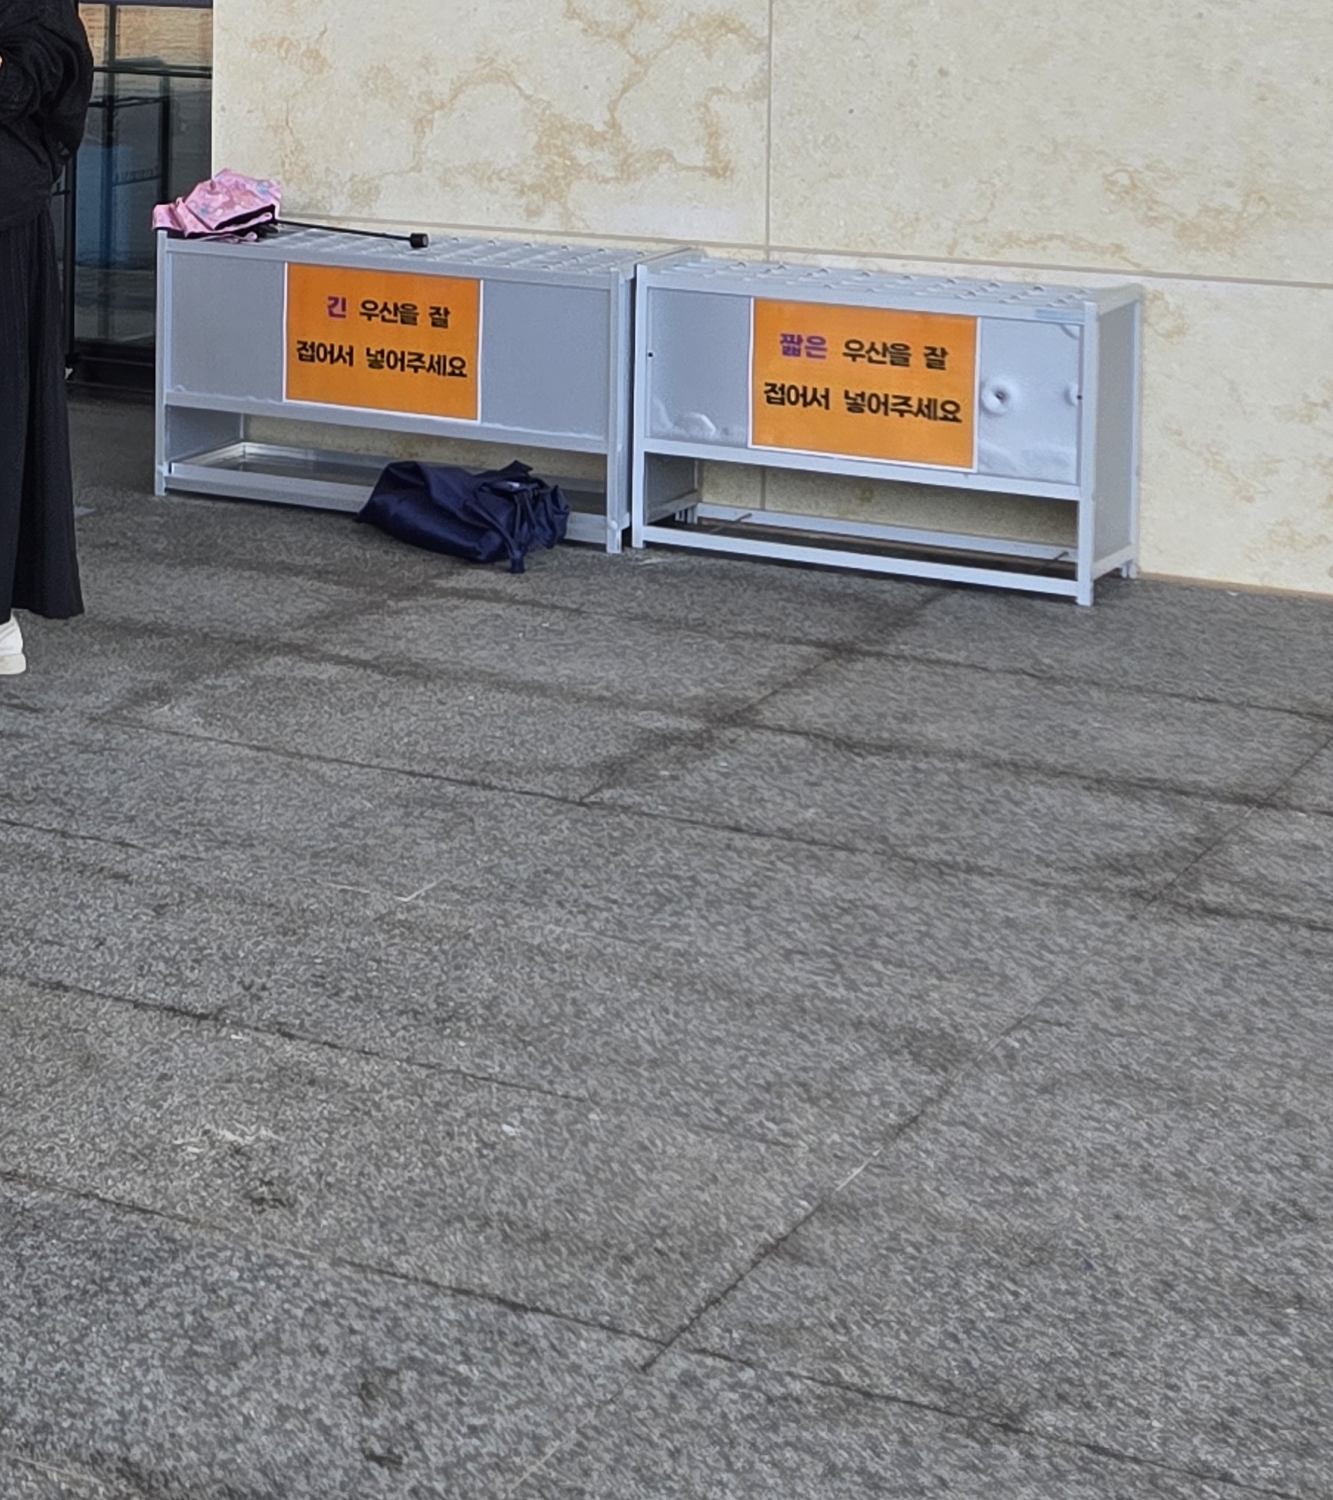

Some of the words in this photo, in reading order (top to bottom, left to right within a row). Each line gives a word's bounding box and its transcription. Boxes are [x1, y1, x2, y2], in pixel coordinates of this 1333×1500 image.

[327, 295, 346, 319] 긴
[359, 299, 419, 326] 우산을
[429, 306, 450, 329] 잘
[296, 340, 354, 367] 접어서
[366, 347, 468, 378] 넣어주세요
[779, 332, 828, 360] 짧은
[842, 338, 912, 368] 우산을
[923, 346, 948, 371] 잘
[763, 382, 830, 410] 접어서
[843, 389, 963, 423] 넣어주세요
